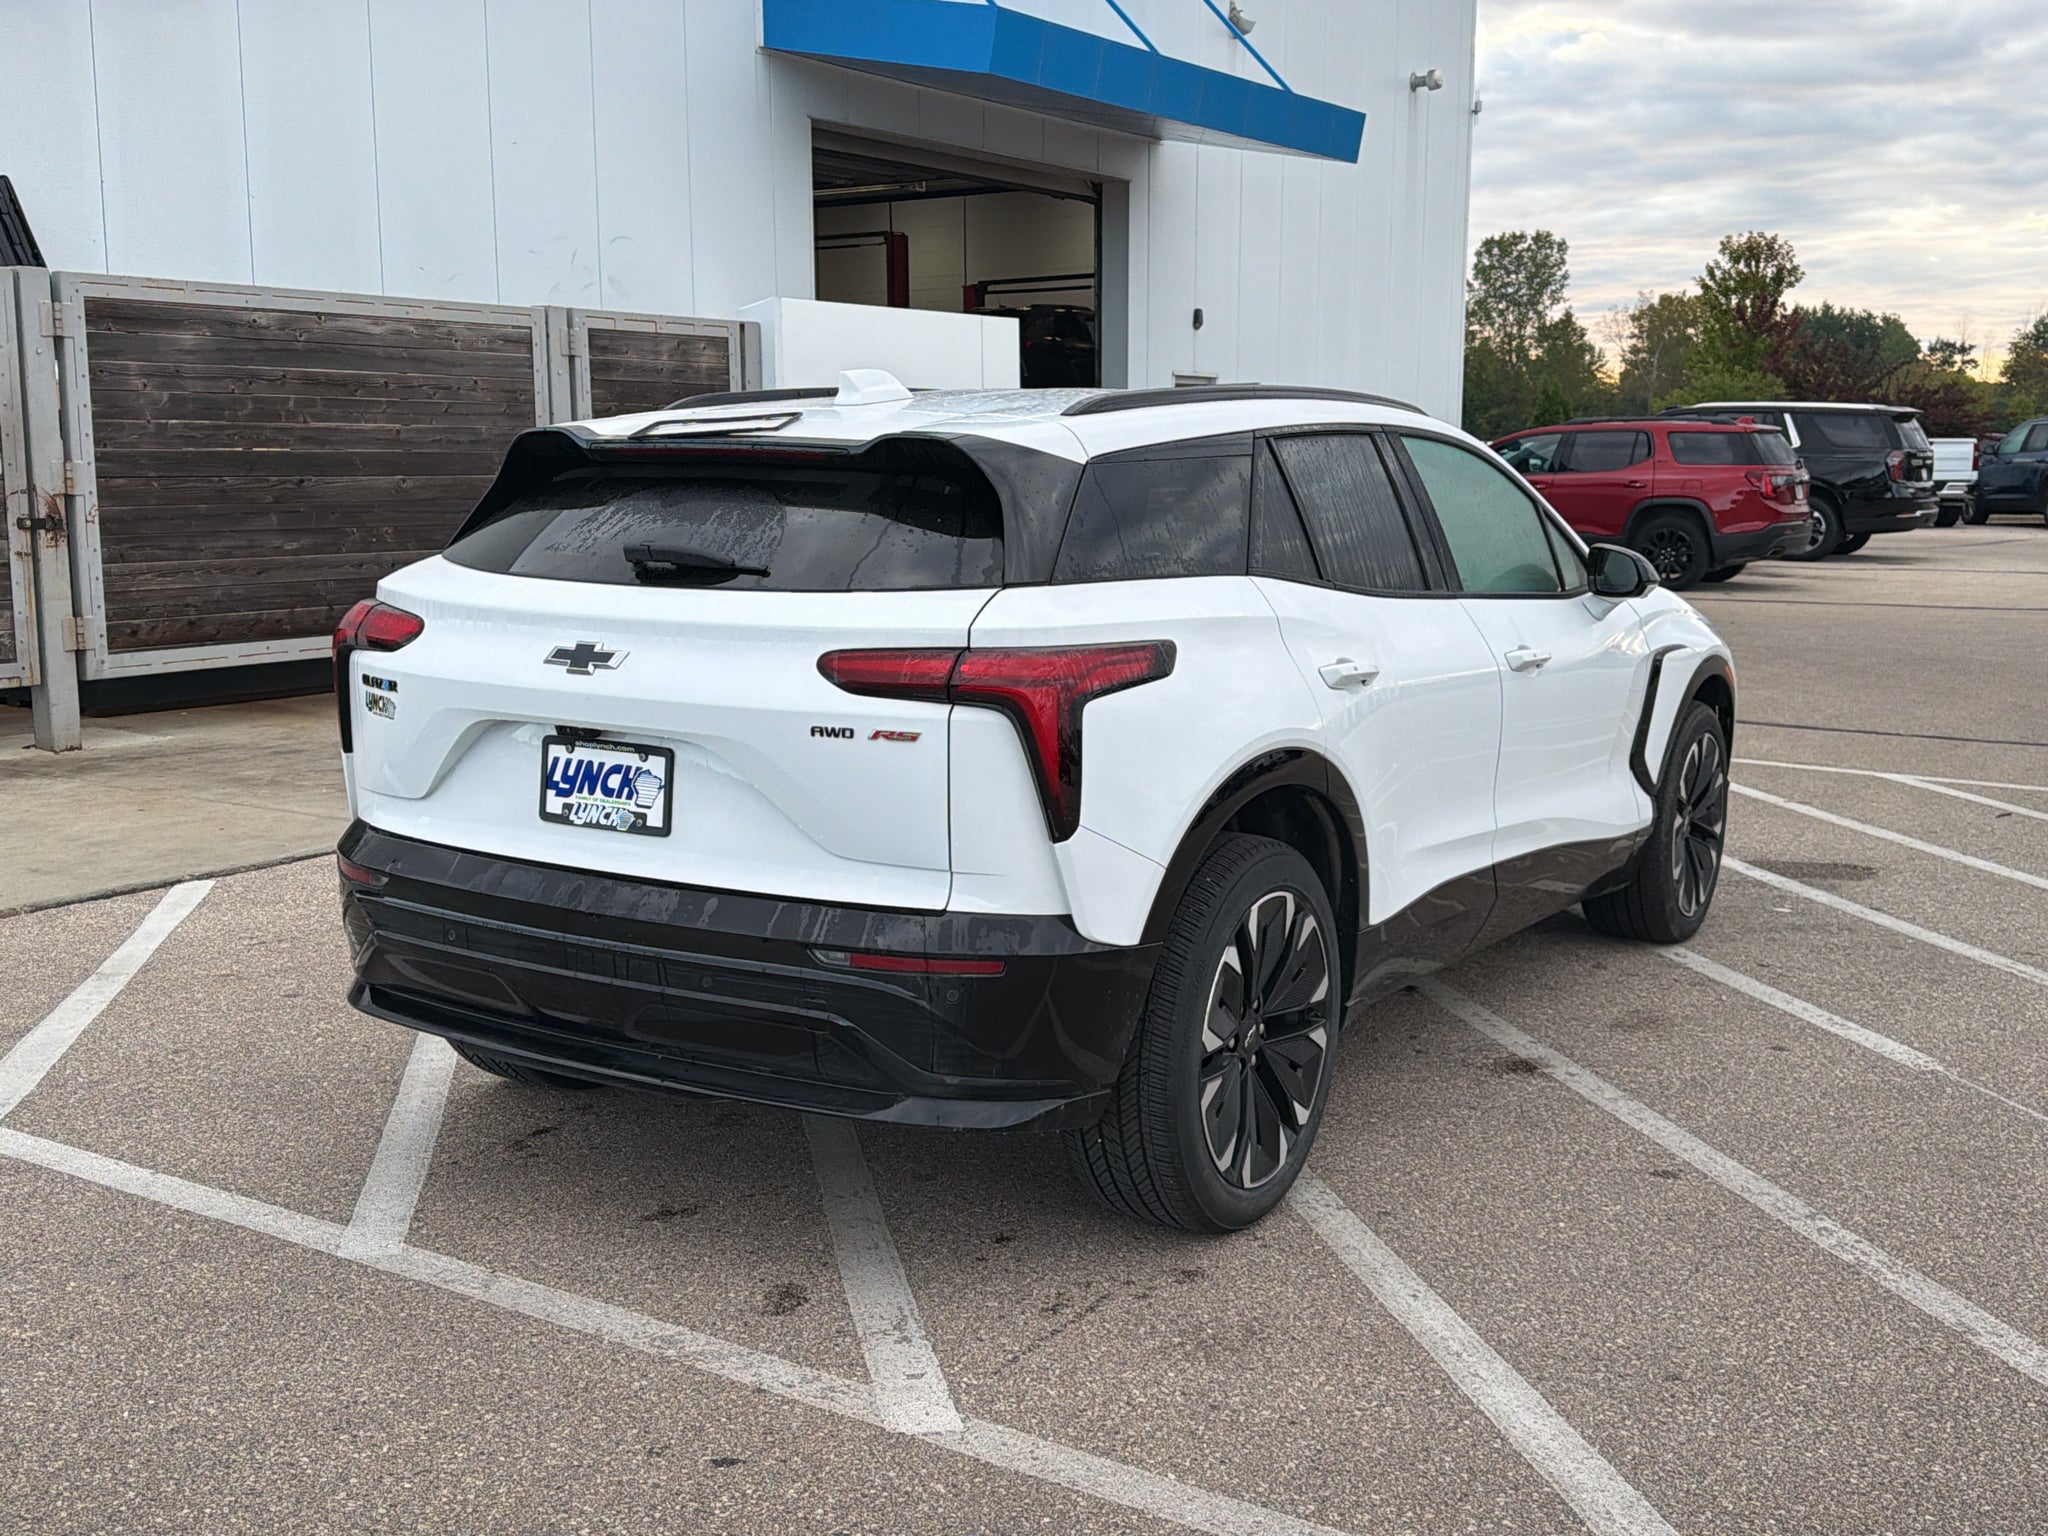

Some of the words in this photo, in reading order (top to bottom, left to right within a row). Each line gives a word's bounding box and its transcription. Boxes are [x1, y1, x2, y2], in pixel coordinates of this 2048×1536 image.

[810, 726, 854, 739] AWD
[868, 729, 922, 742] RS
[575, 740, 635, 752] shoplynch.com
[546, 756, 643, 800] LYNCH
[569, 802, 620, 826] LYNCH
